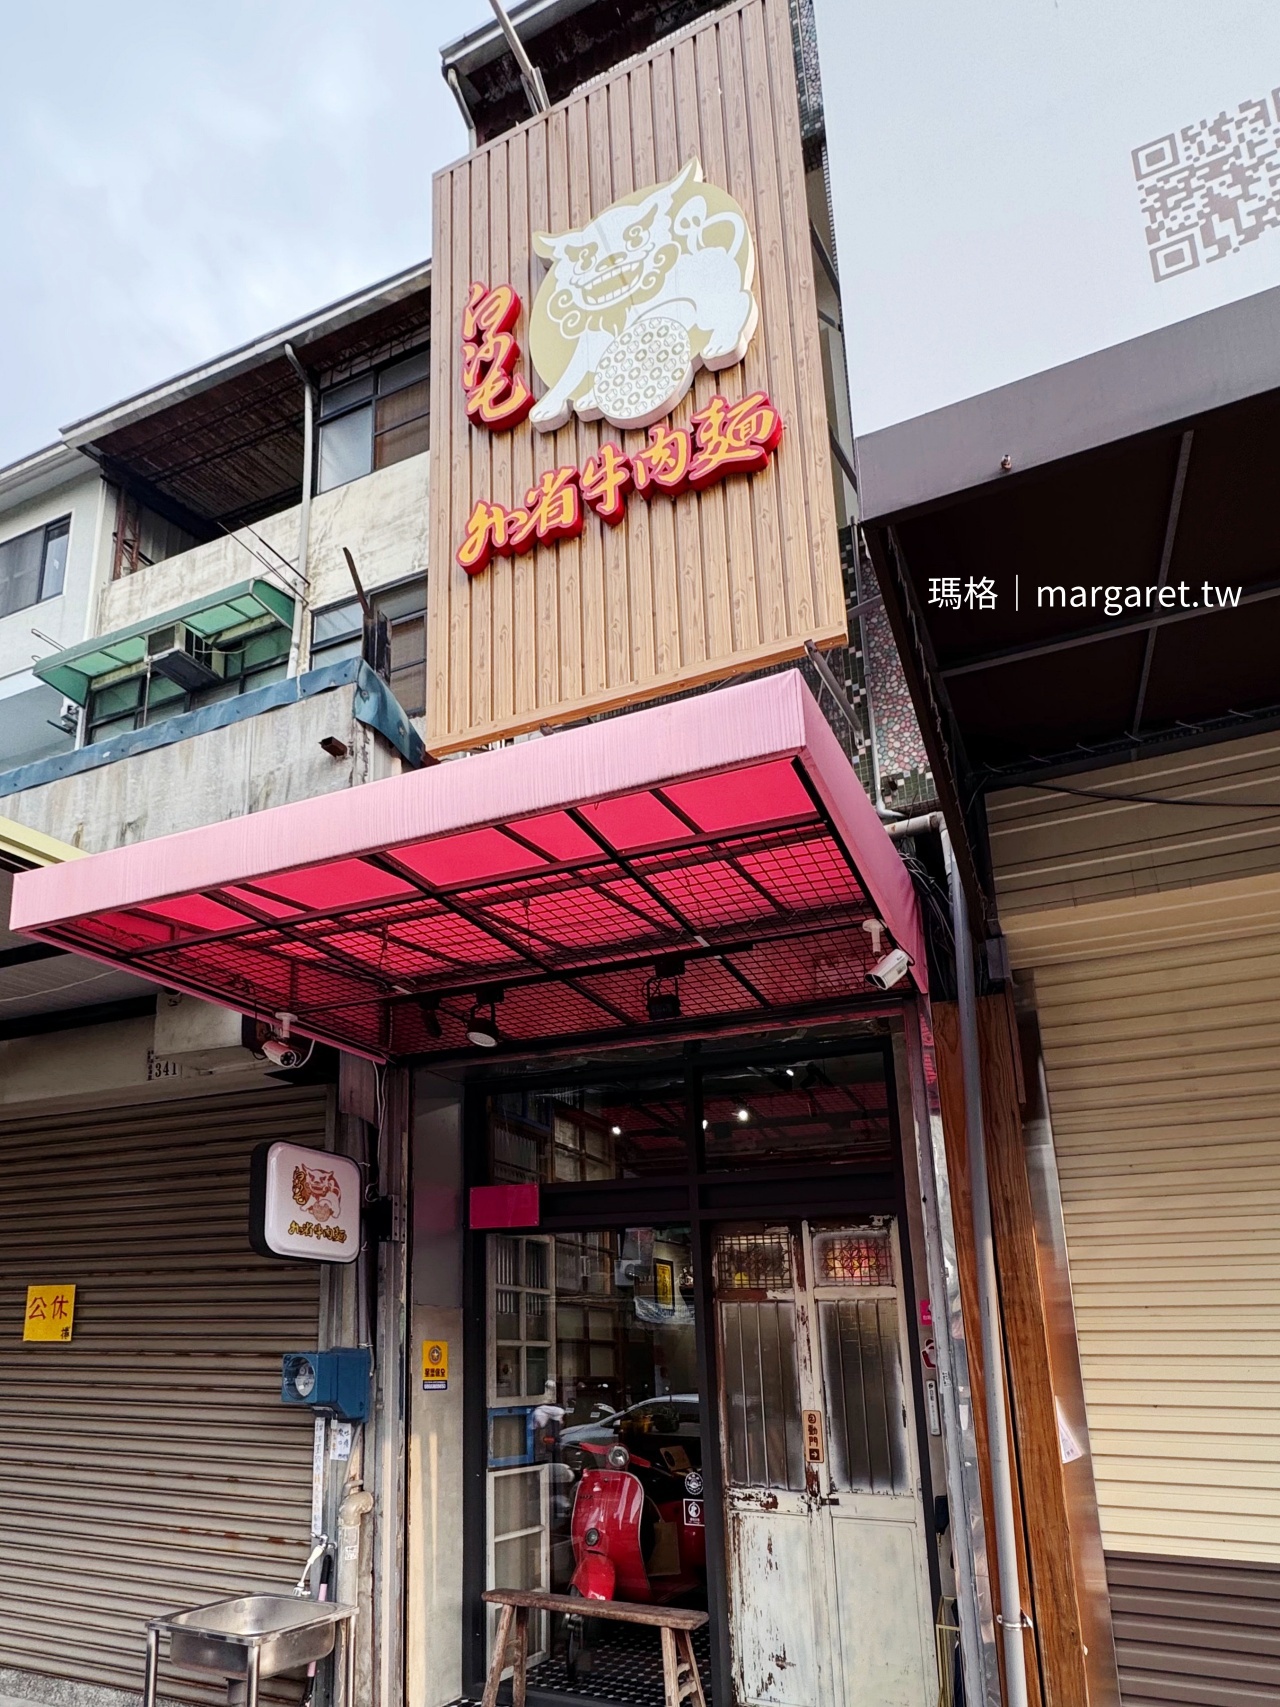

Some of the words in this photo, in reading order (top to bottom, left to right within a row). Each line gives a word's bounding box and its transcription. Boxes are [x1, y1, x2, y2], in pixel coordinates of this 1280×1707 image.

[456, 391, 783, 574] 外省牛肉麵
[155, 1061, 177, 1078] 341
[29, 1295, 69, 1320] 公休
[807, 1413, 818, 1447] 自動門
